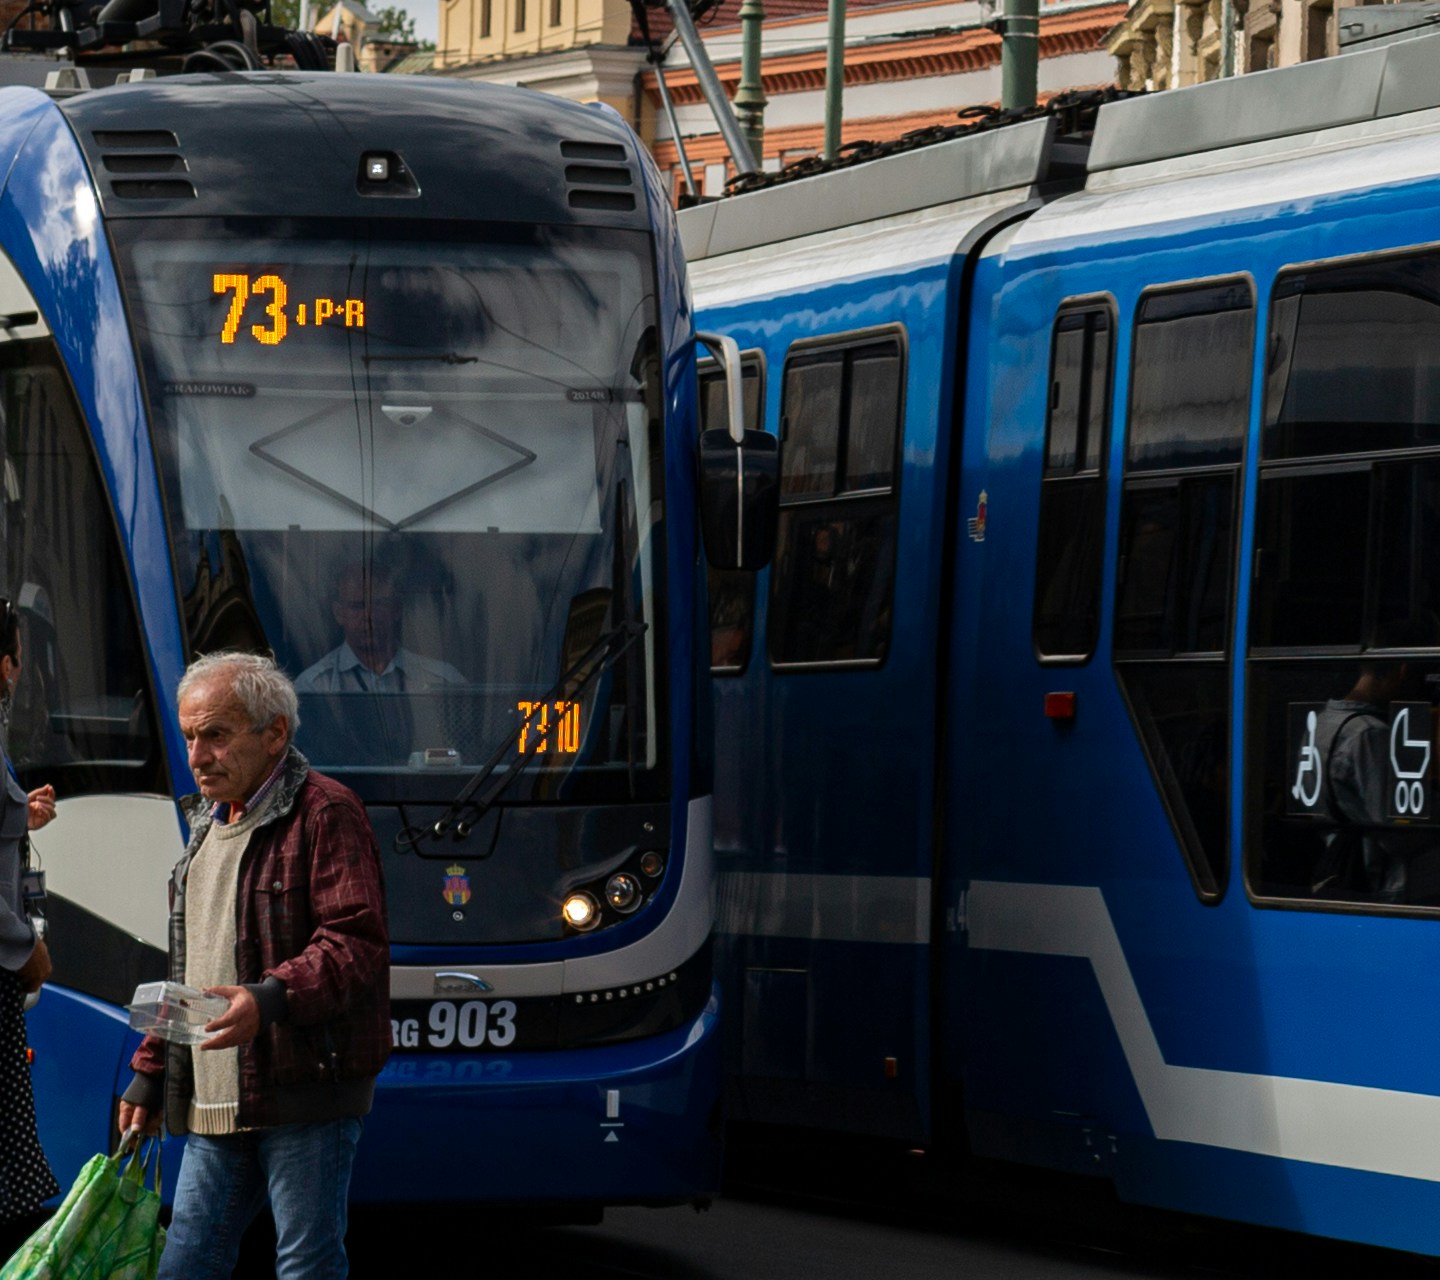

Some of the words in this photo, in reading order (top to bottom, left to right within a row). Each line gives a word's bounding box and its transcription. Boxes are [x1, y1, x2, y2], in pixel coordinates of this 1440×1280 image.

[213, 273, 288, 345] 73
[315, 298, 365, 328] P+R
[427, 999, 518, 1049] 903
